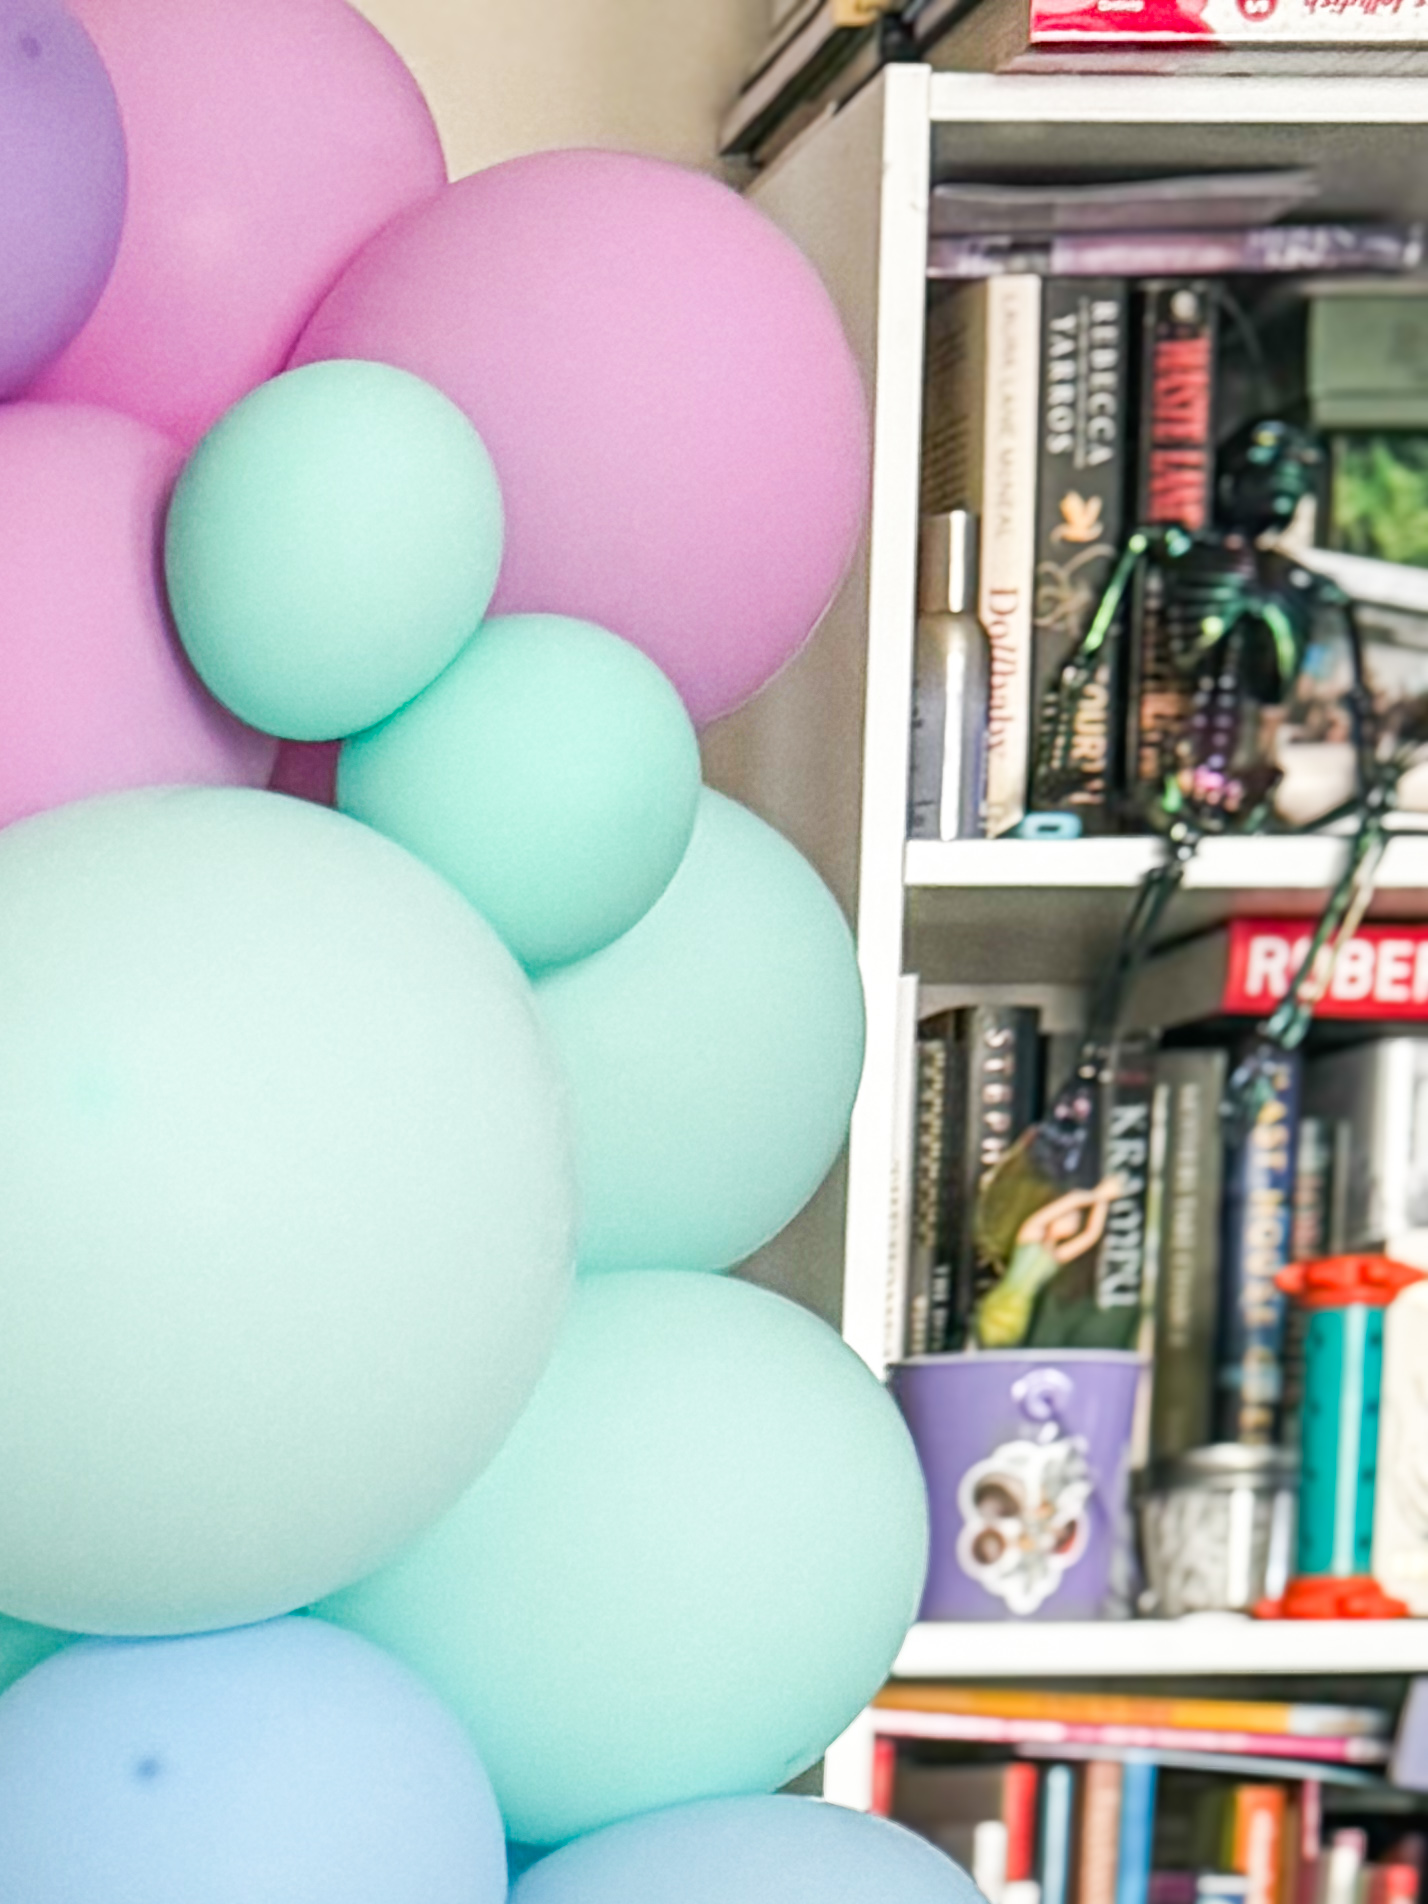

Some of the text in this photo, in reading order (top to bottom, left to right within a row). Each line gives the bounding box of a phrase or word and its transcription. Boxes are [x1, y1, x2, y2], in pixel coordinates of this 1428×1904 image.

[1047, 312, 1077, 455] YARROS
[1088, 299, 1119, 468] REBECCA
[980, 1027, 1015, 1188] STEPH
